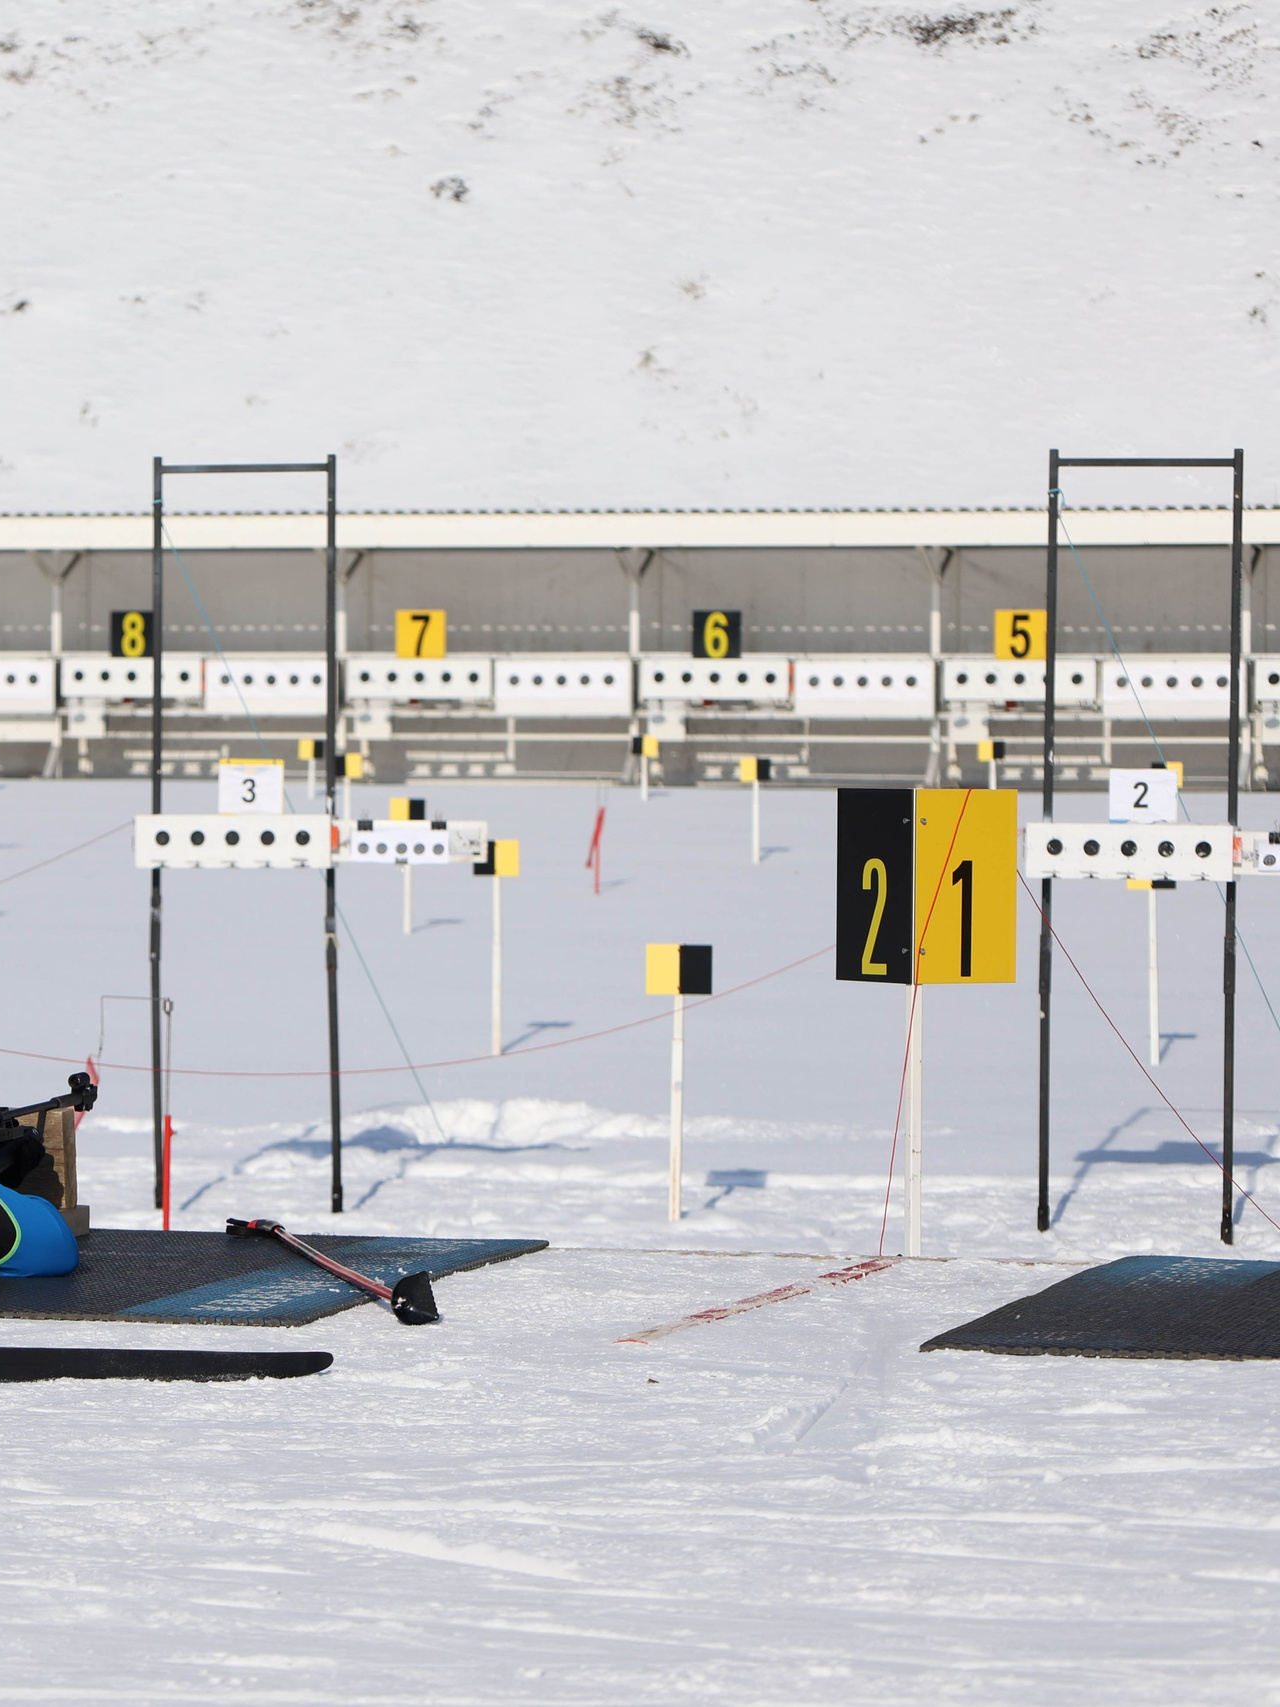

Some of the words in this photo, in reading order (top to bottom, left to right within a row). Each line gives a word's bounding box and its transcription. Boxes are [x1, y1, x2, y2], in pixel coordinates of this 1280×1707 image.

[120, 612, 146, 656] 8
[410, 614, 431, 657] 7
[703, 612, 729, 658] 6
[1010, 614, 1032, 659] 5
[241, 778, 256, 803] 3
[1133, 782, 1149, 808] 2
[861, 858, 888, 976] 2
[952, 860, 973, 977] 1
